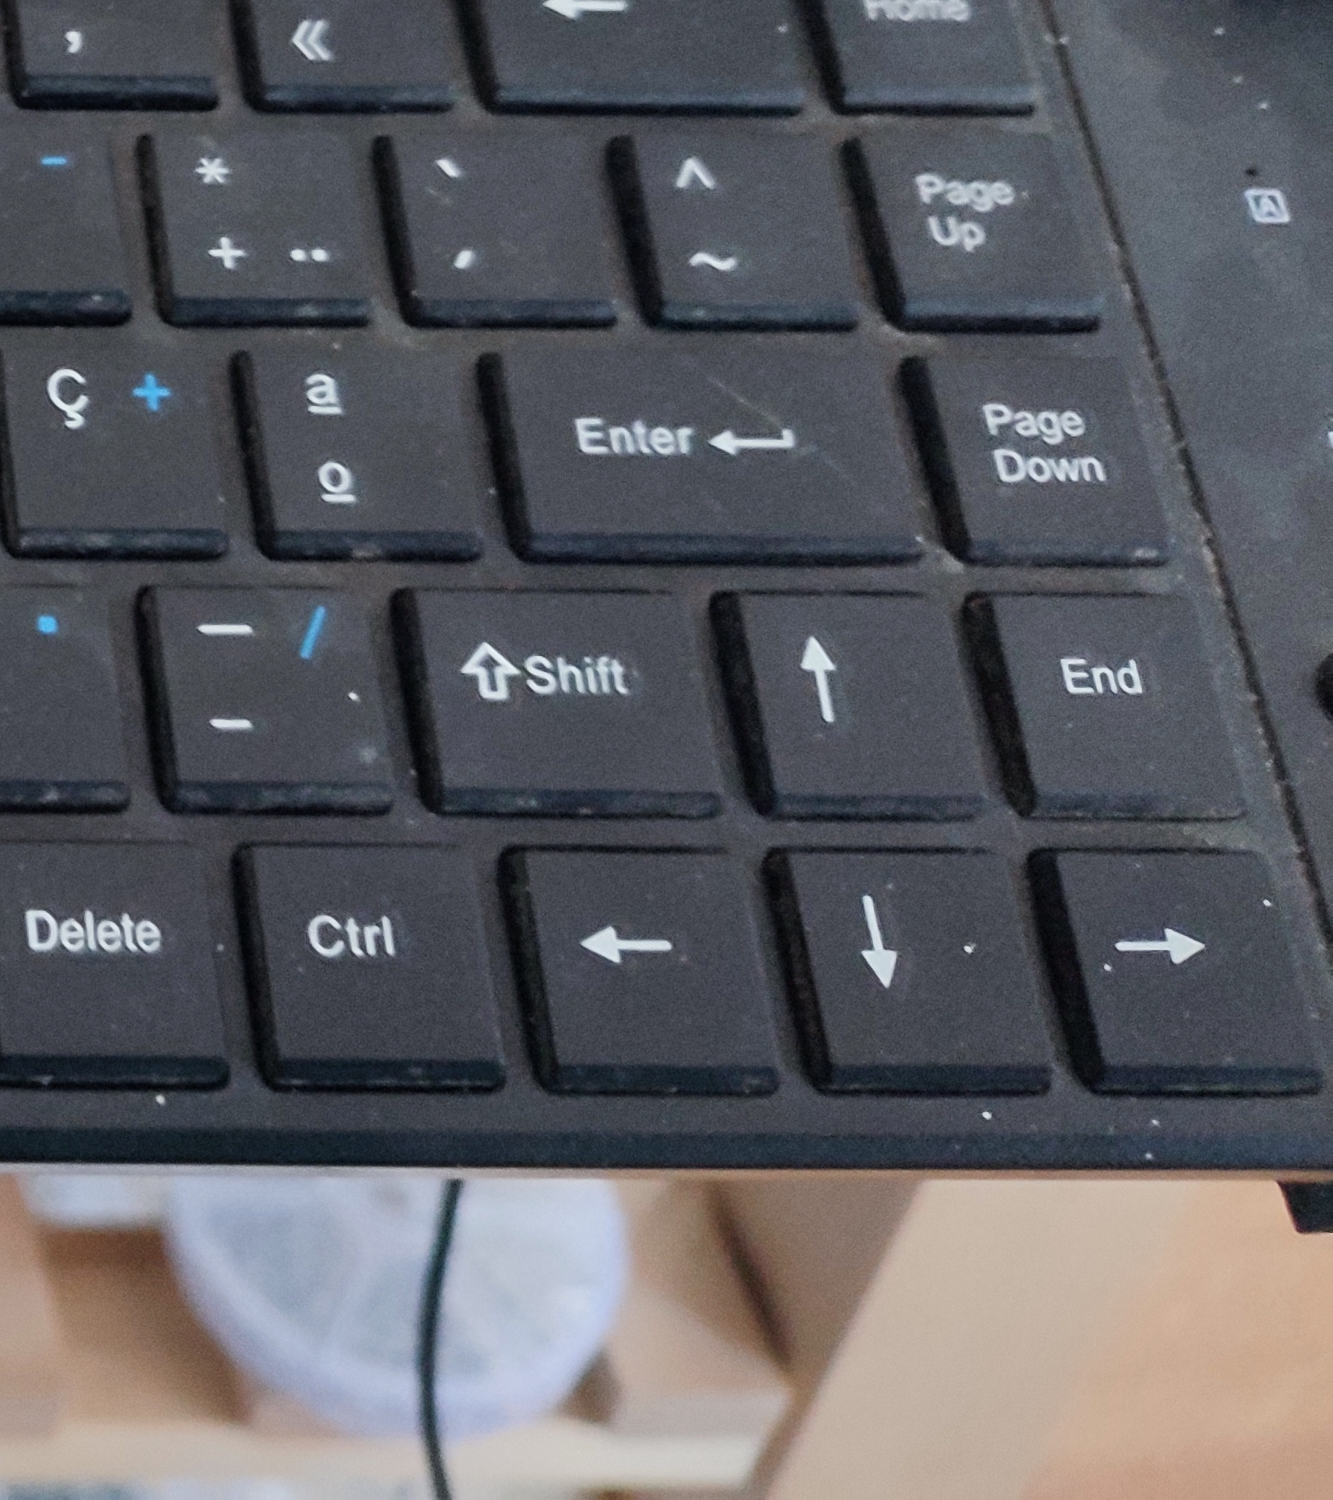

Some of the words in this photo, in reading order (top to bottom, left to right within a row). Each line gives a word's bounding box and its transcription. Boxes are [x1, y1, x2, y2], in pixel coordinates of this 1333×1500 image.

[913, 172, 1017, 214] Page
[926, 214, 987, 253] Up
[573, 416, 695, 457] Enter
[980, 401, 1087, 447] Page
[991, 446, 1107, 485] Down
[523, 653, 630, 696] Shift
[1059, 656, 1145, 696] End
[24, 908, 163, 955] Delete
[306, 913, 397, 959] Ctrl
